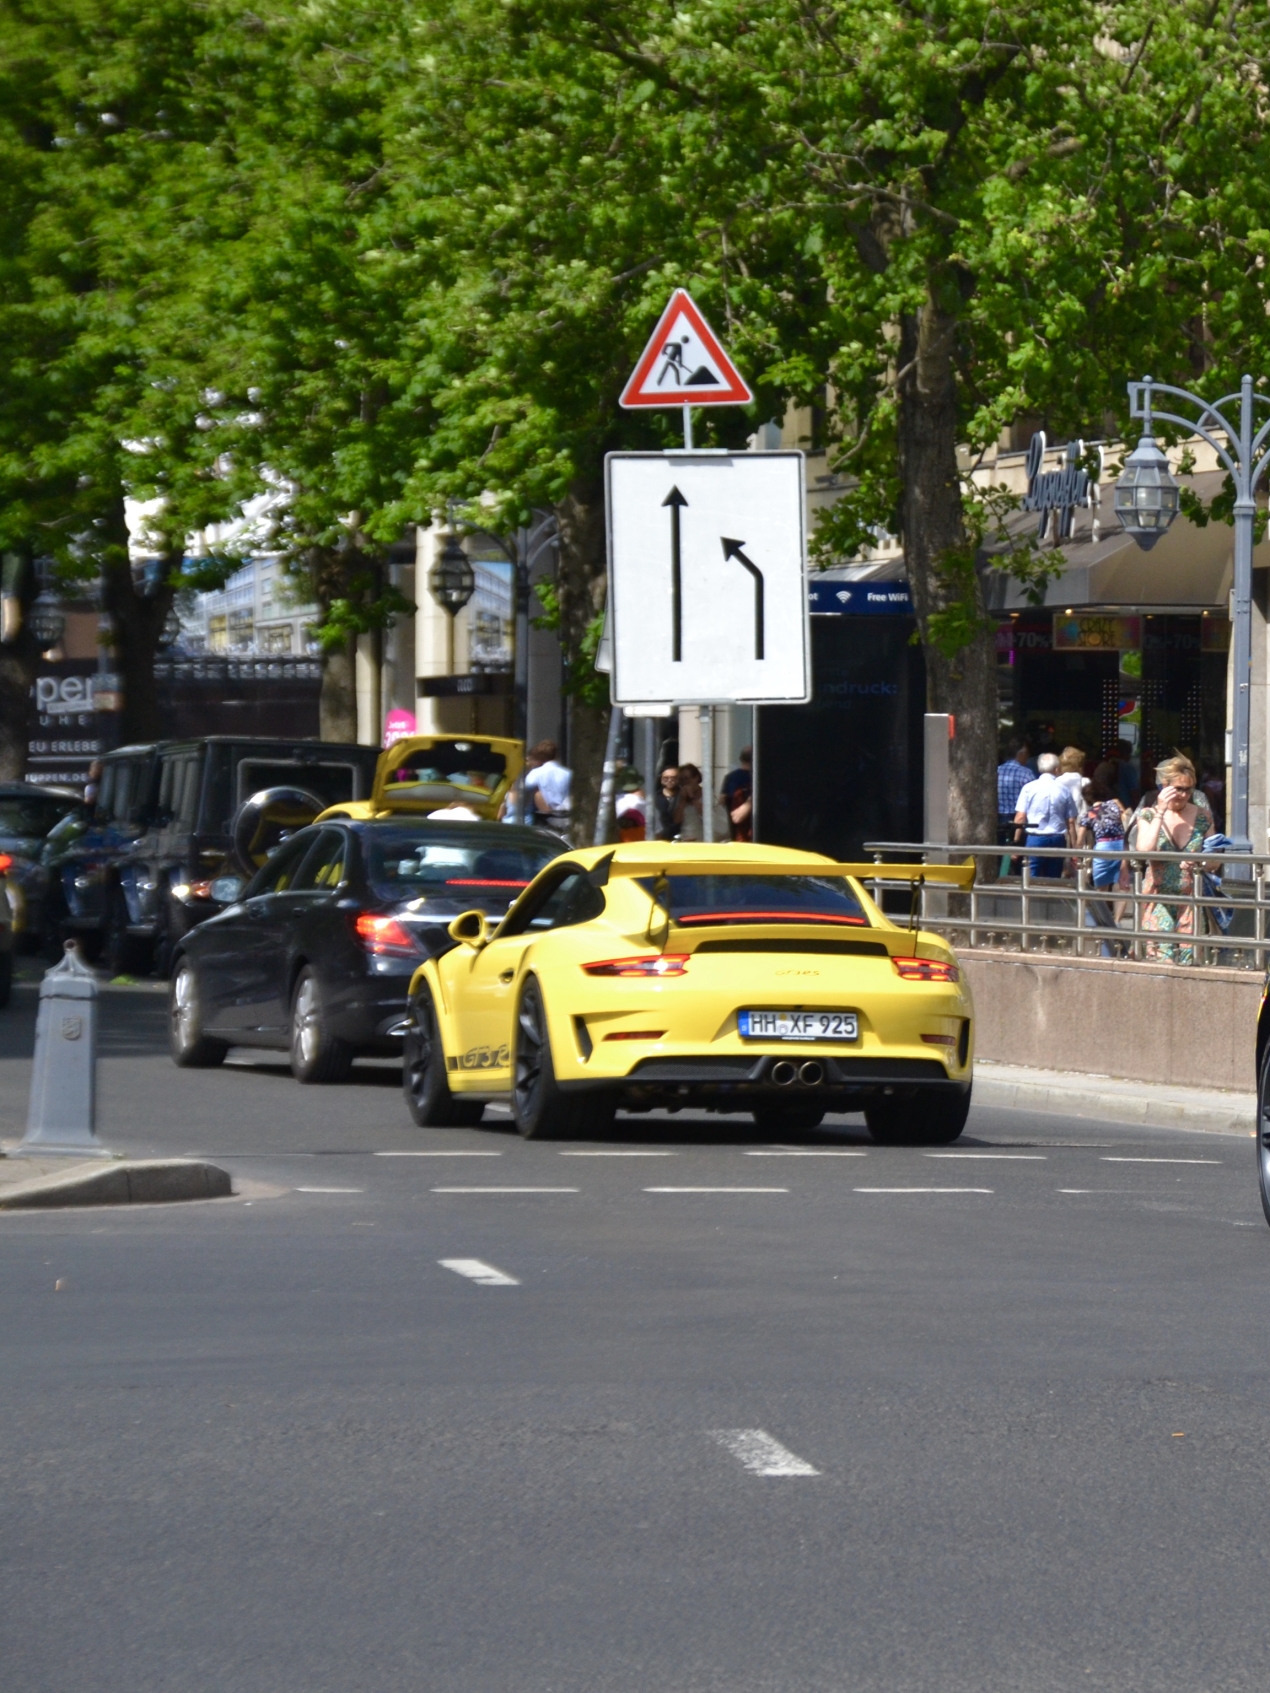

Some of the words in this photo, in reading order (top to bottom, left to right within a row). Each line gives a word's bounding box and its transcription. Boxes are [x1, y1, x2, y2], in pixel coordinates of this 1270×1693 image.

[867, 592, 887, 602] Free
[888, 593, 908, 602] WiFi
[1078, 631, 1116, 647] STORE
[751, 1013, 777, 1033] HH
[790, 1014, 814, 1034] XF
[820, 1015, 856, 1035] 925
[463, 1046, 491, 1068] GT3
[495, 1044, 510, 1067] R
